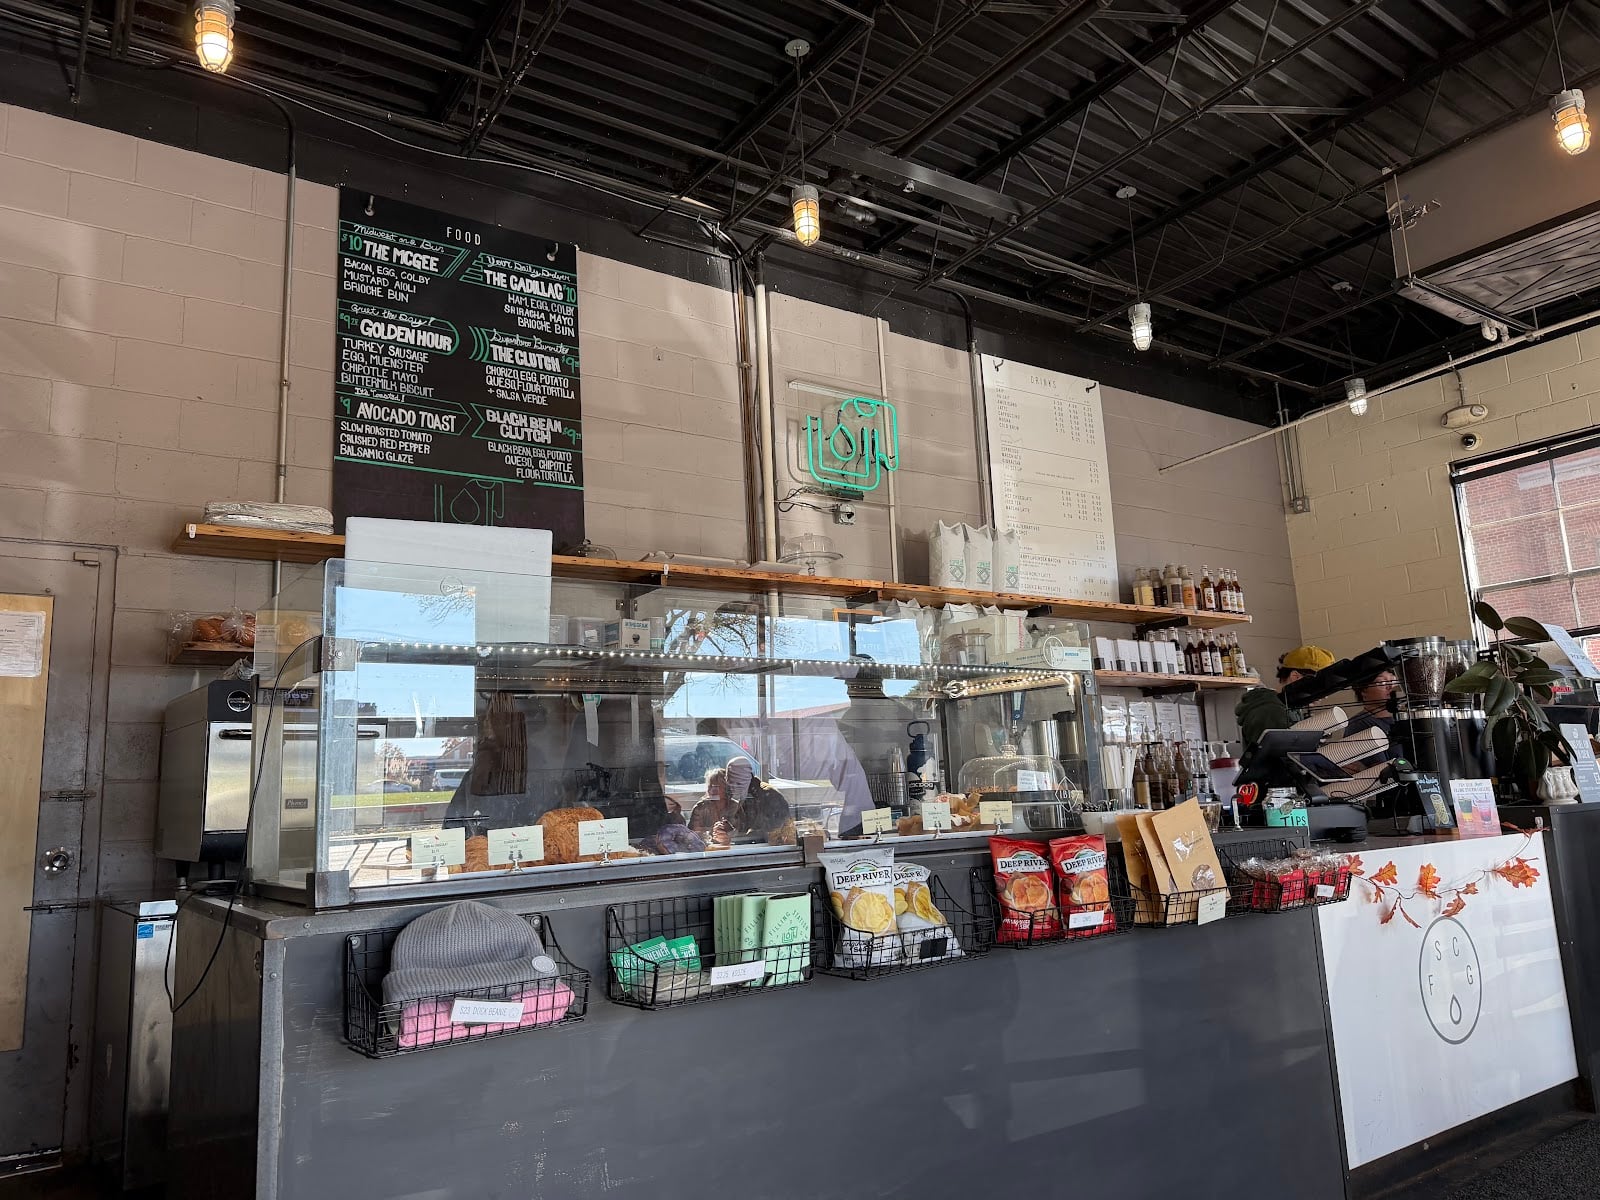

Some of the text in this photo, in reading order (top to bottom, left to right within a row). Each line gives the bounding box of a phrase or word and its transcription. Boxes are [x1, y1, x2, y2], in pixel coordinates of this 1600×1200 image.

[353, 223, 398, 242] Midwest
[420, 239, 445, 253] Bun
[446, 226, 482, 246] FOOD
[341, 233, 440, 273] $10 THE MCGEE
[344, 258, 431, 285] BACON, EGG, COLBY
[486, 255, 513, 269] Your
[513, 262, 541, 278] Daily
[343, 269, 417, 294] MUSTARD AIOLI
[343, 280, 409, 303] BRIOCHE BUN
[483, 269, 577, 303] THE CADILLAC $10
[350, 303, 380, 316] Greet
[503, 304, 574, 327] SRIRACHA MAYO
[550, 302, 575, 317] COLBY
[360, 318, 416, 345] GOLDEN
[416, 330, 453, 352] HOUR
[517, 316, 576, 338] BRIOCHE BUN
[342, 337, 430, 364] TURKEY SAUSAGE
[342, 349, 424, 374] EGG, MUENSTER
[489, 343, 515, 364] THE
[514, 348, 562, 373] CLUTCH
[341, 361, 418, 384] CHIPOTLE MAYO
[539, 373, 569, 389] POTATO
[340, 372, 435, 398] BUTTERMILK BISCUIT
[517, 380, 541, 394] FLOUR
[540, 384, 576, 400] TORTILLA
[495, 388, 521, 402] SALSA
[521, 393, 549, 406] VERDE
[356, 401, 417, 427] AVOCADO
[419, 410, 457, 433] TOAST
[485, 408, 563, 434] BLACK BEAN
[340, 420, 433, 443] SLOW ROASTED TOMATO
[500, 423, 552, 444] CLUTCH
[339, 433, 431, 455] CRUSHED RED PEPPER
[339, 443, 414, 465] BALSAMIC GLAZE
[487, 441, 513, 456] BLACK
[547, 450, 572, 462] POTATO
[504, 454, 573, 474] QUESO, CHIPOTLE
[516, 467, 576, 484] FLOUR TORTILLA
[1000, 859, 1023, 869] DEEP
[1064, 859, 1086, 871] DEEP
[836, 869, 891, 885] DEEP RIVER
[893, 871, 916, 881] DEEP
[768, 911, 791, 936] FILLING
